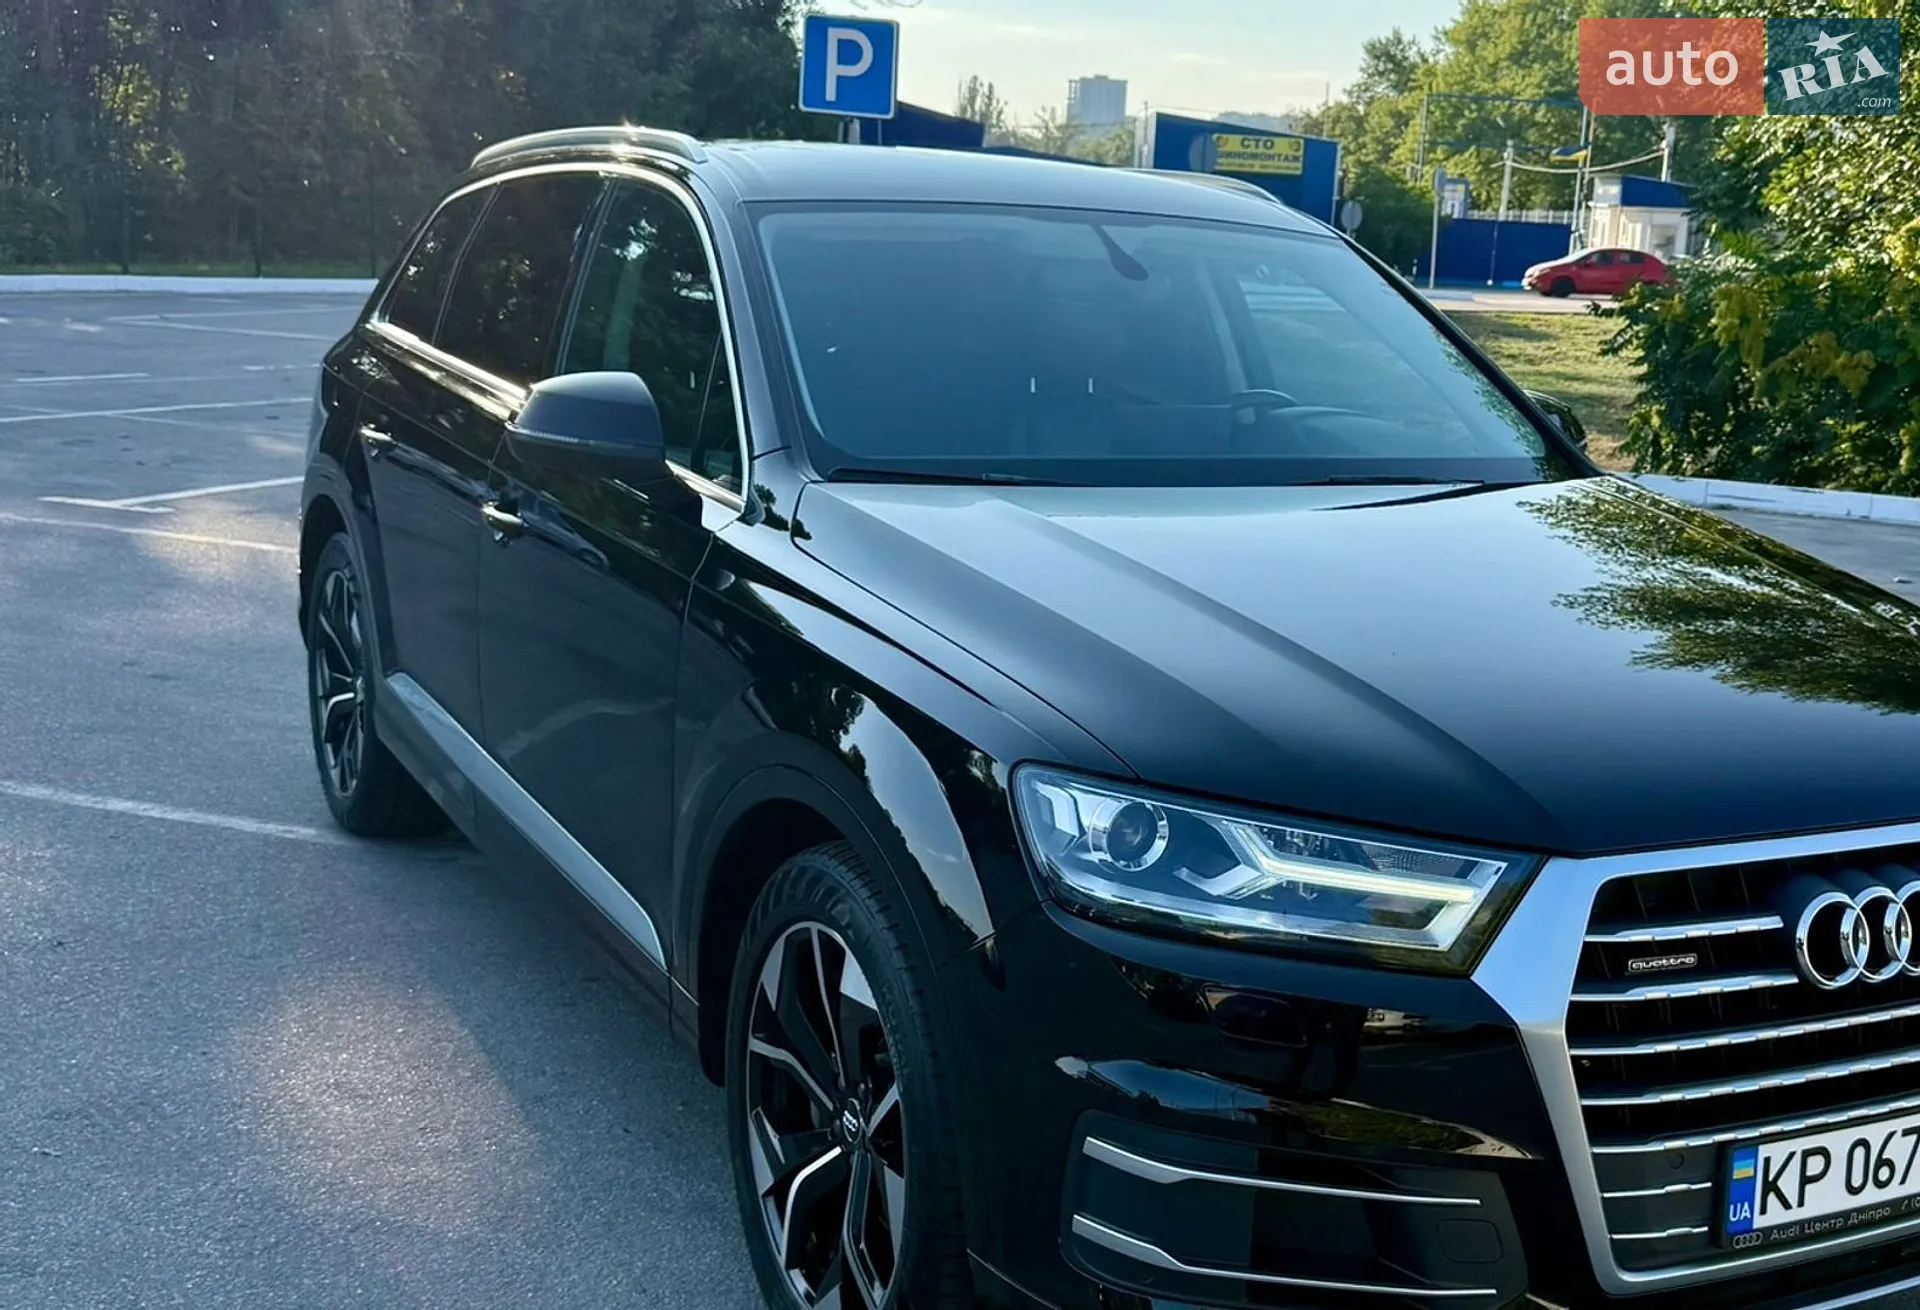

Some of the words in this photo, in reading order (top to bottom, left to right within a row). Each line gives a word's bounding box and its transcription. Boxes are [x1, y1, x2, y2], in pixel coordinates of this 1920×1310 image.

[825, 27, 873, 102] P
[1240, 137, 1275, 150] СТО
[1632, 956, 1695, 970] quattro
[1759, 1146, 1832, 1216] KP
[1729, 1201, 1752, 1222] UA
[1770, 1226, 1800, 1241] Audi
[1804, 1216, 1844, 1235] Центр
[1848, 1205, 1892, 1226] Дніпро
